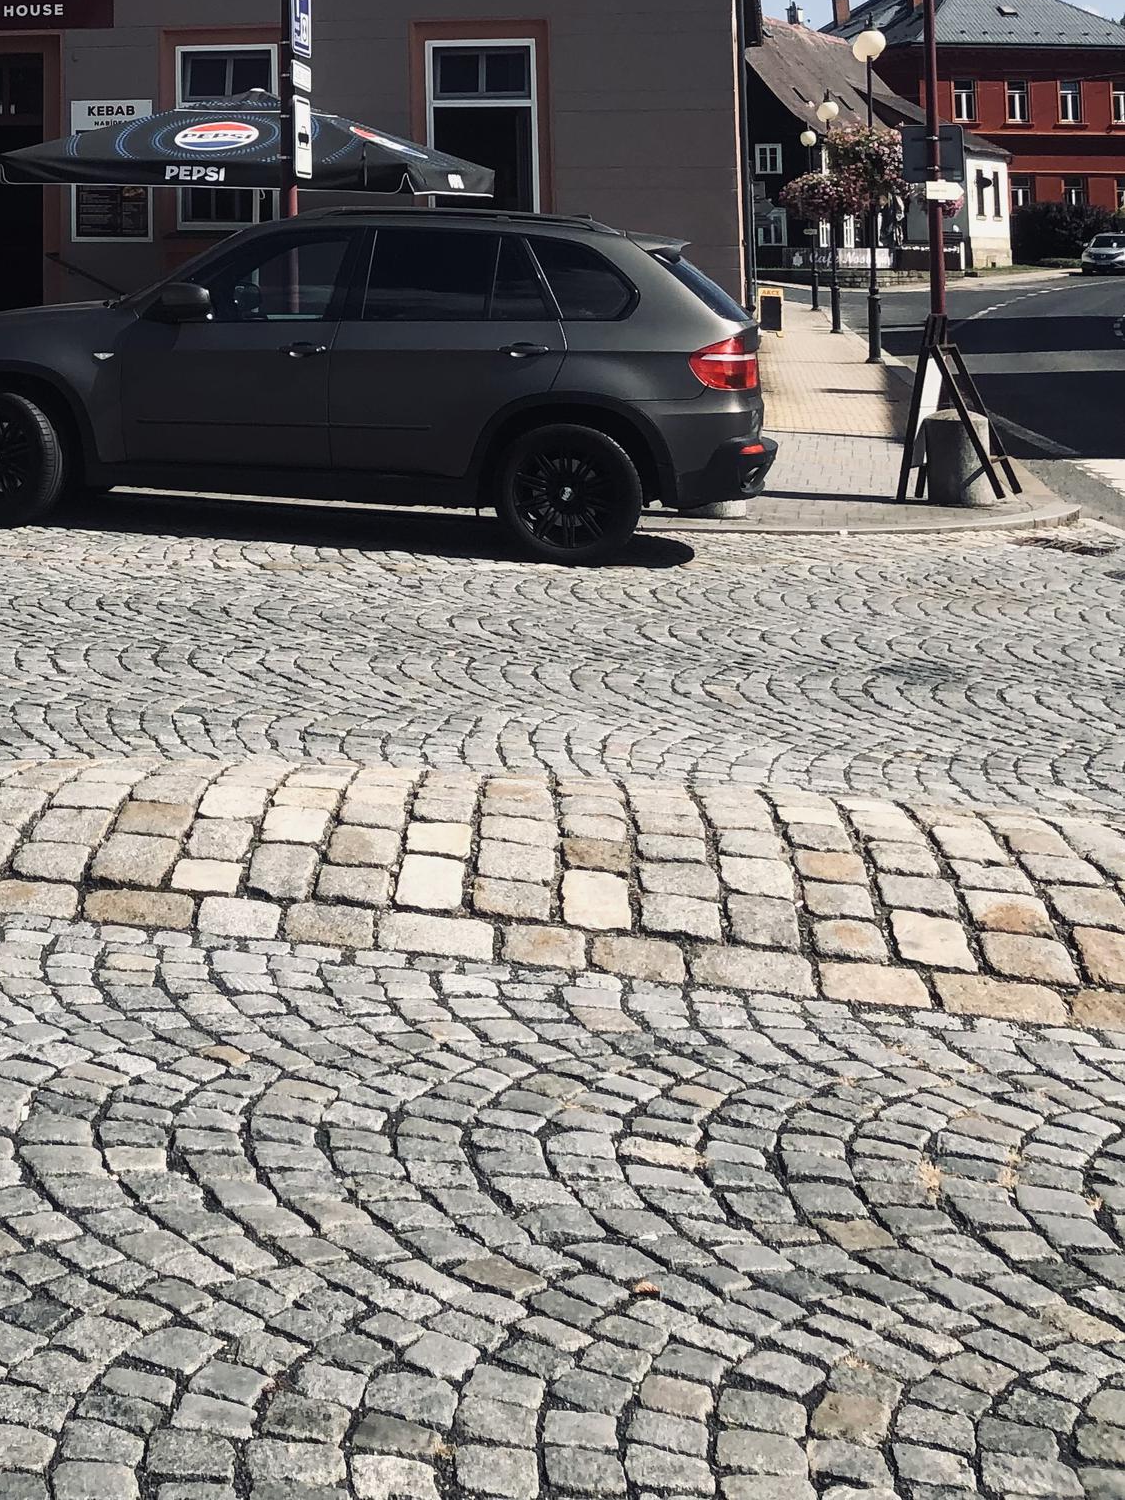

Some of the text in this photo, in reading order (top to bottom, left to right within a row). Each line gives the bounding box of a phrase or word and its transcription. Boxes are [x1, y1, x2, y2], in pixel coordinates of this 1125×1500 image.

[3, 3, 64, 17] HOUSE
[87, 105, 135, 116] KEBAB
[165, 166, 225, 181] PEPSI
